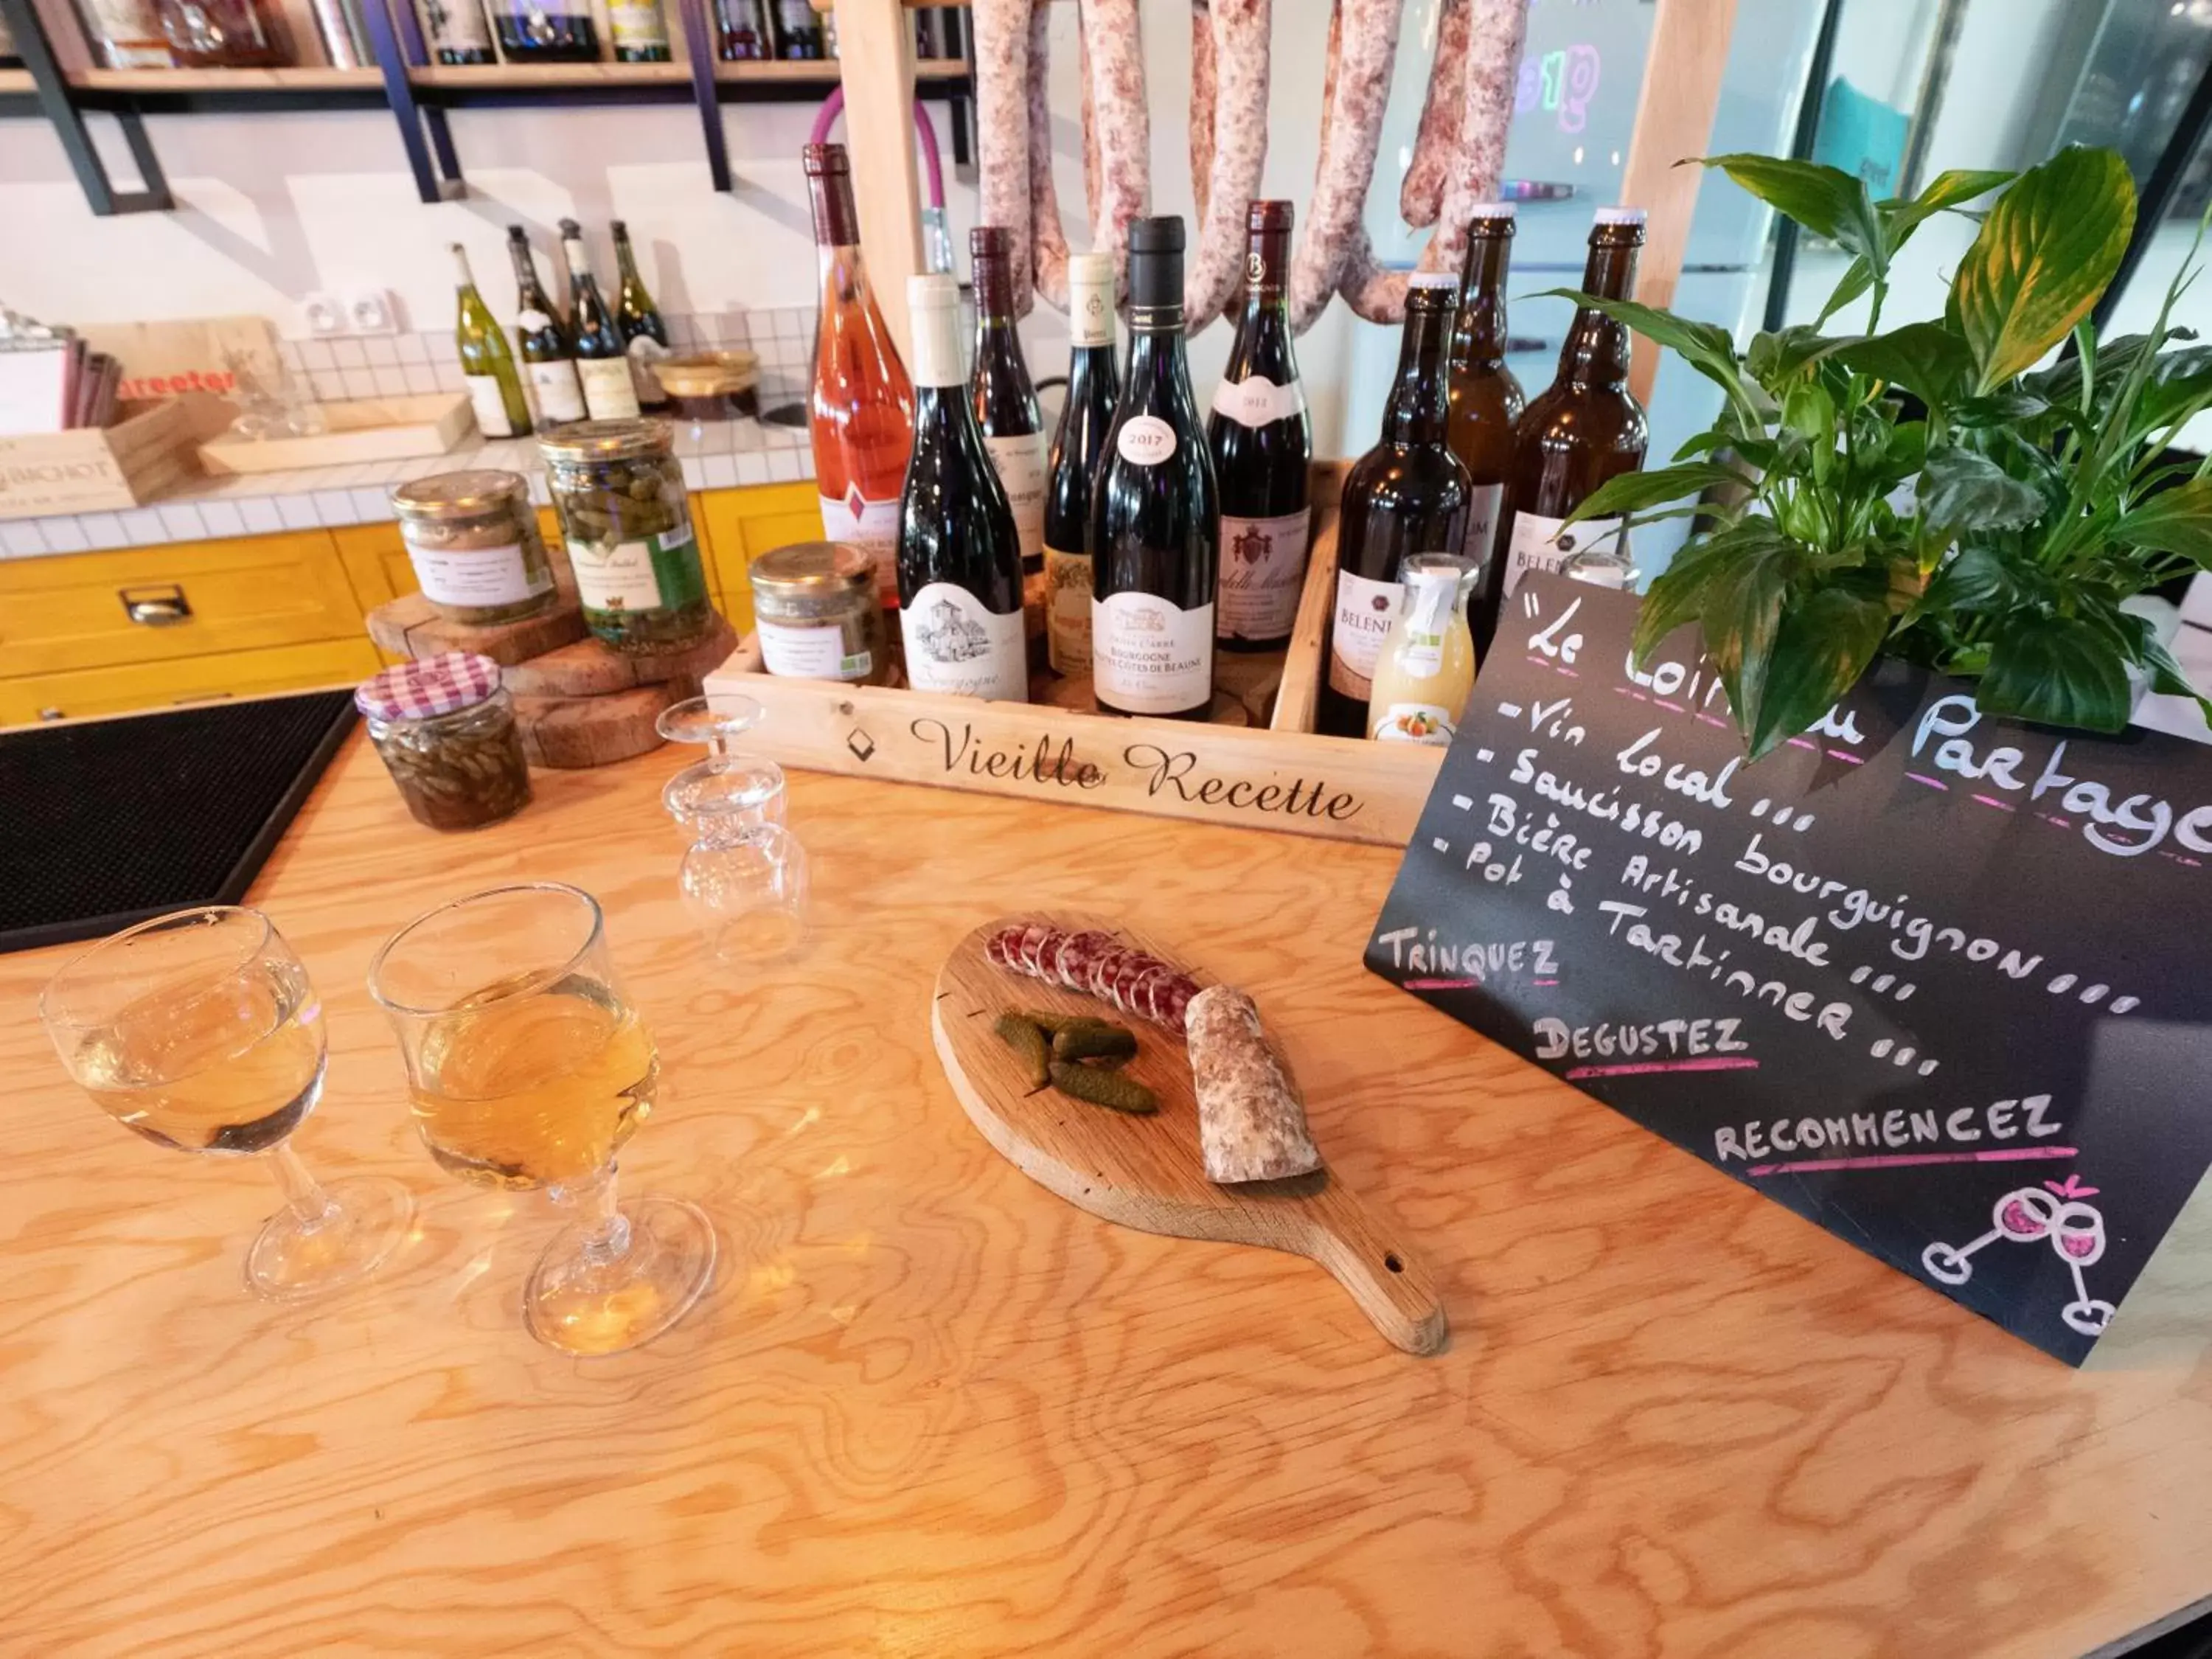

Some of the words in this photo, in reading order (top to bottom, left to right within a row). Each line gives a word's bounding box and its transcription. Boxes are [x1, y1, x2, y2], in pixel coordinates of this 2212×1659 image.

[1129, 434, 1163, 446] 2017
[1530, 697, 1586, 747] Vin
[910, 717, 1106, 789] Vieille
[1124, 743, 1365, 821] Recette
[1547, 873, 1575, 915] à
[1532, 1017, 1750, 1060] DEGUSTEZ
[1714, 1094, 2063, 1163] RECOMMENCEZ
